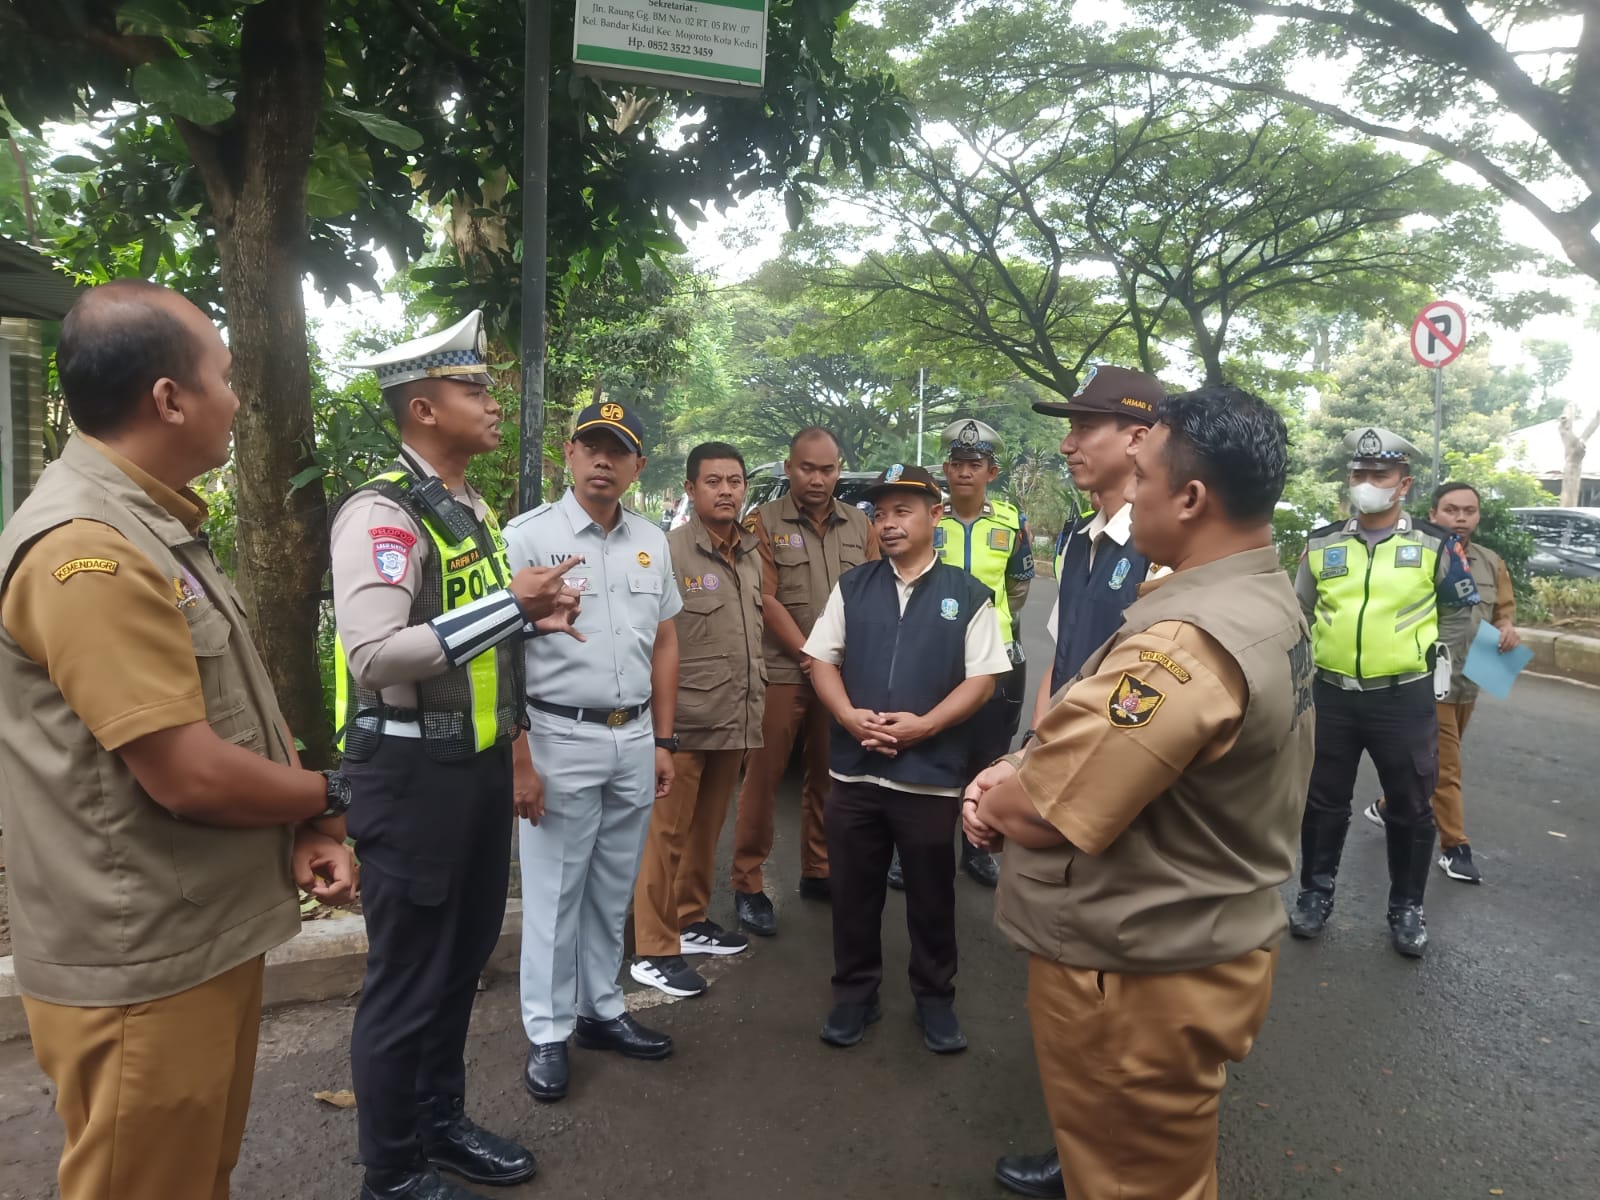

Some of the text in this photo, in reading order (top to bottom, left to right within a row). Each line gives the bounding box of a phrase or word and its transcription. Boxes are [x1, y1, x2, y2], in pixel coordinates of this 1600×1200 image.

[608, 5, 635, 19] Raung
[685, 17, 695, 26] 02
[711, 20, 721, 30] 05
[740, 25, 751, 34] 07
[600, 18, 631, 31] Bandar
[632, 22, 655, 35] Kidul
[675, 29, 712, 42] Mojoroto
[713, 34, 732, 46] Kota
[734, 37, 759, 49] Kediri
[628, 36, 714, 57] Hp. 0852 3522 3459
[57, 560, 117, 579] KEMENDAGRI
[1022, 554, 1034, 571] B
[1454, 578, 1475, 598] B
